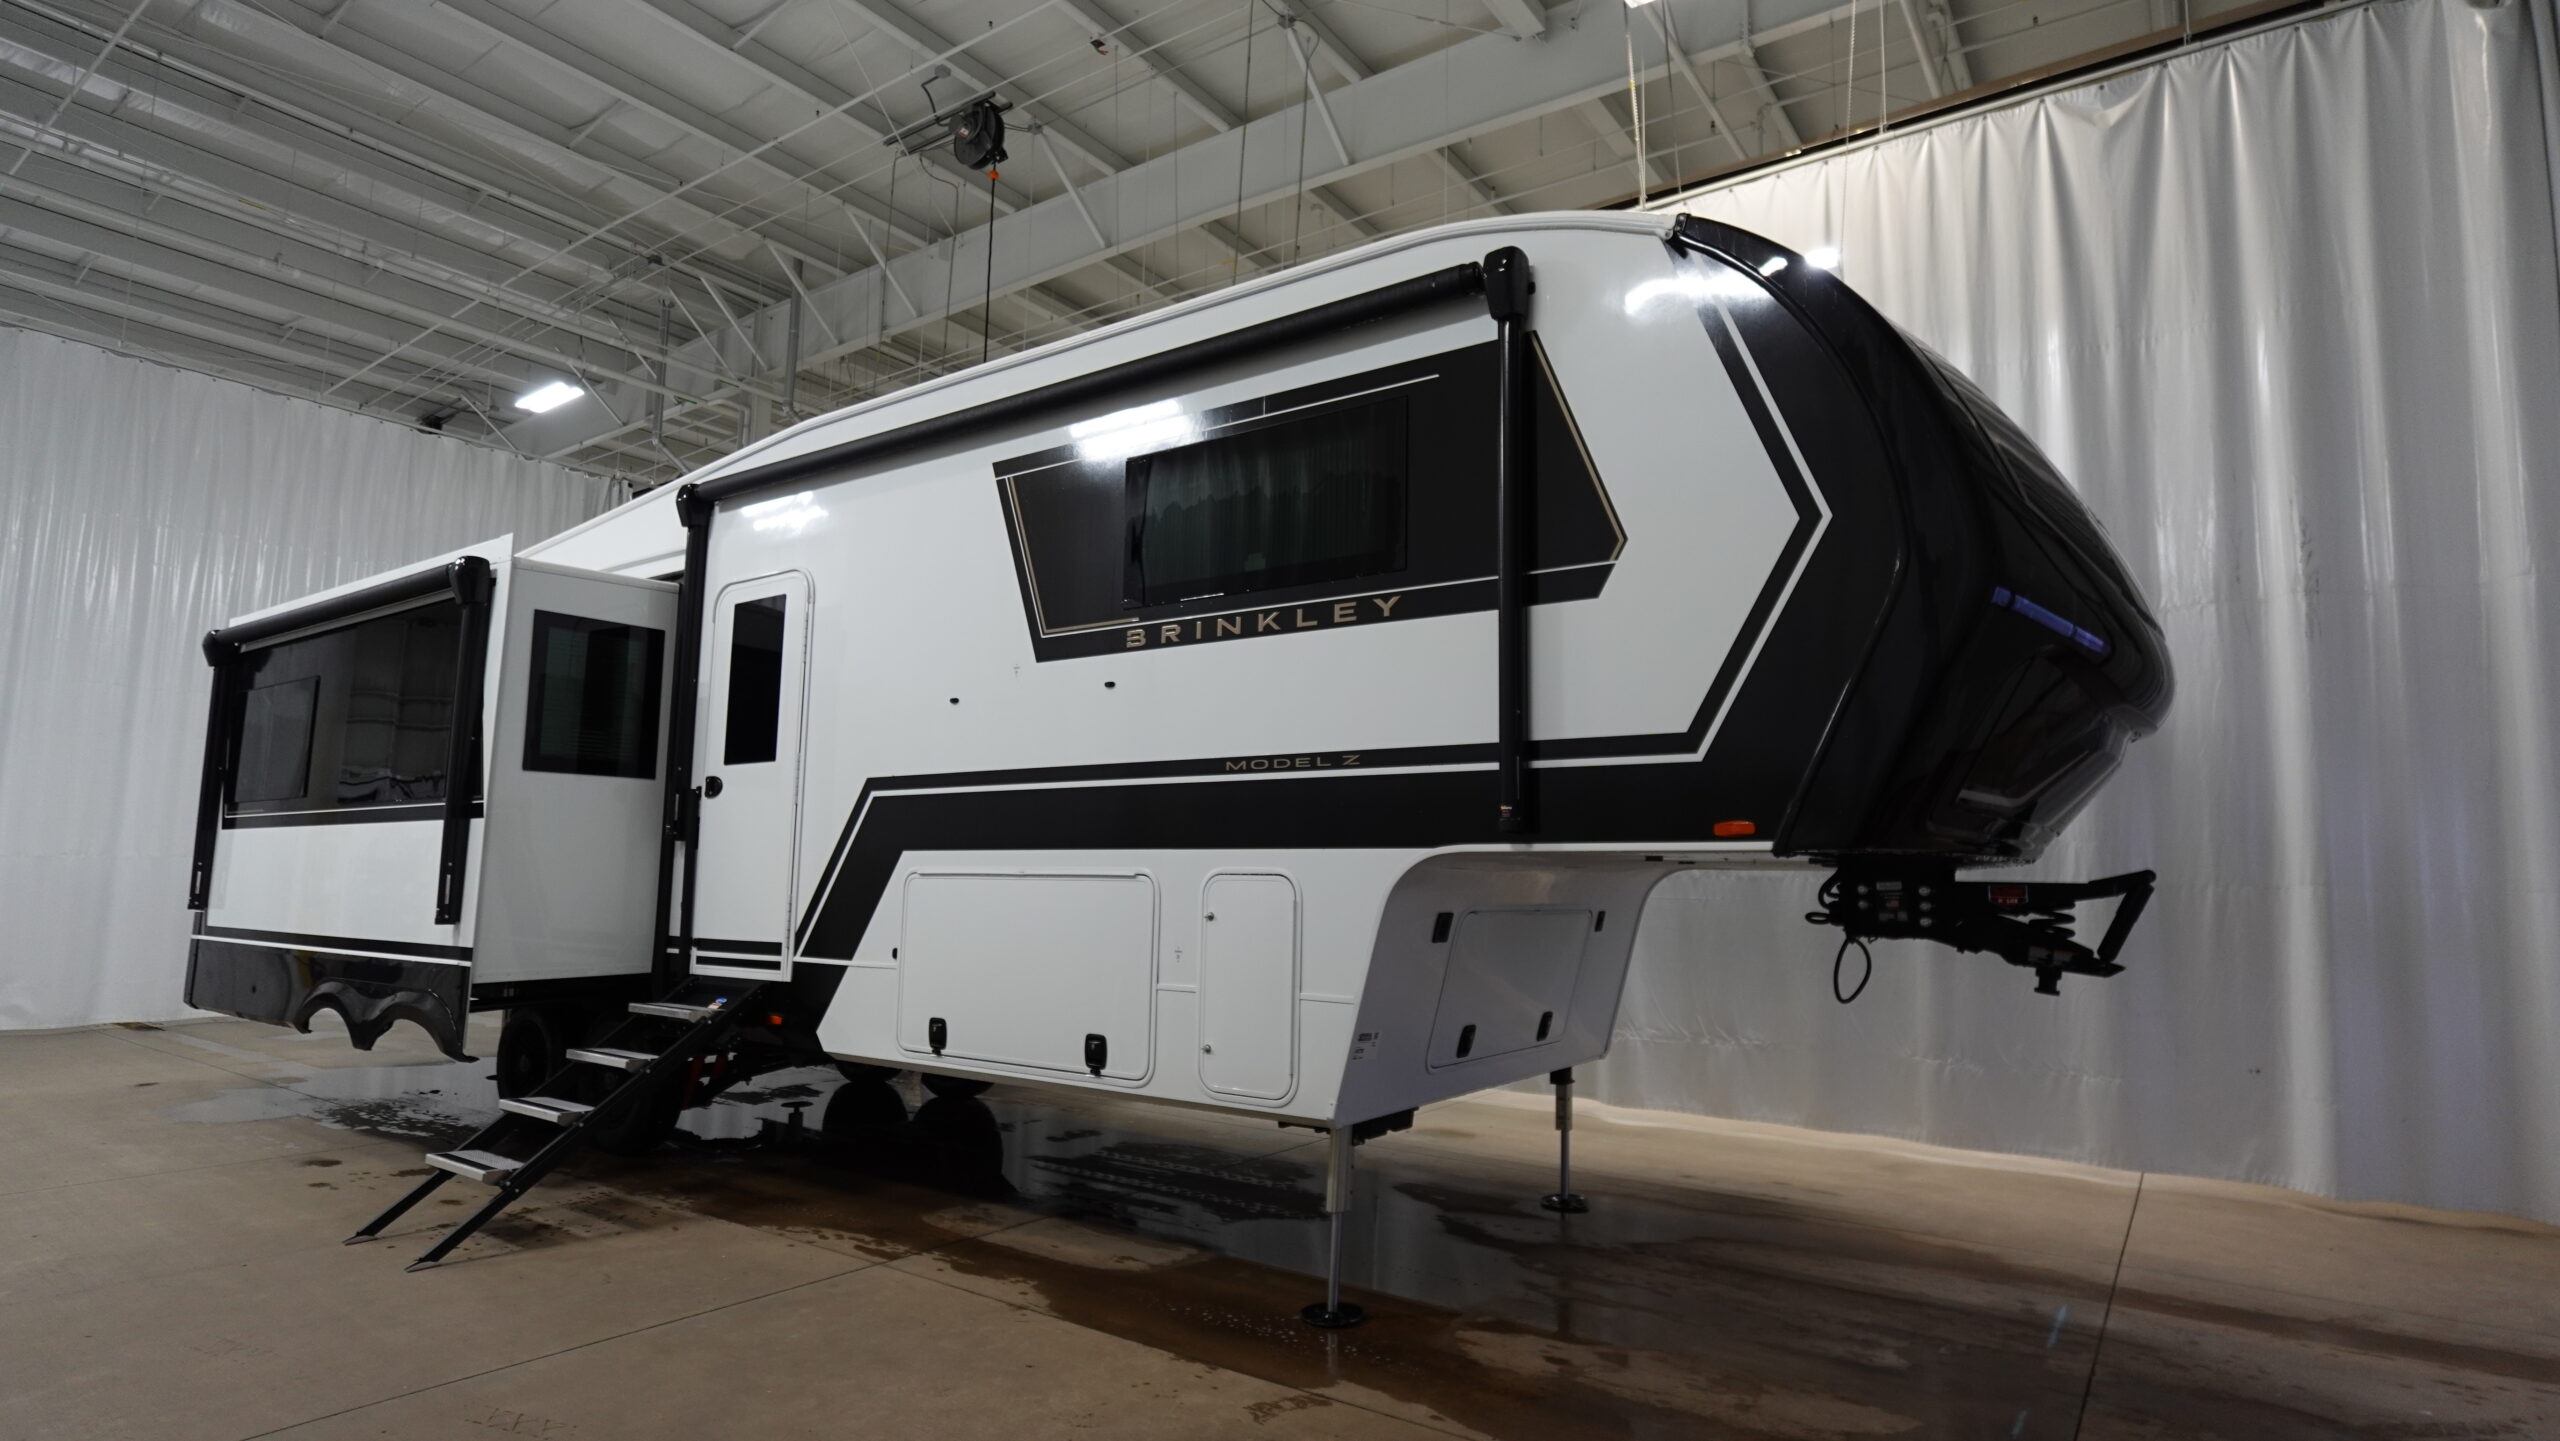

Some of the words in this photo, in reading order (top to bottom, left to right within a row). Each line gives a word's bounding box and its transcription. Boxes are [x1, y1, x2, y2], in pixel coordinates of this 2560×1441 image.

[1126, 596, 1399, 648] BRINKLEY
[1225, 756, 1332, 771] MODEL
[1342, 754, 1361, 766] Z
